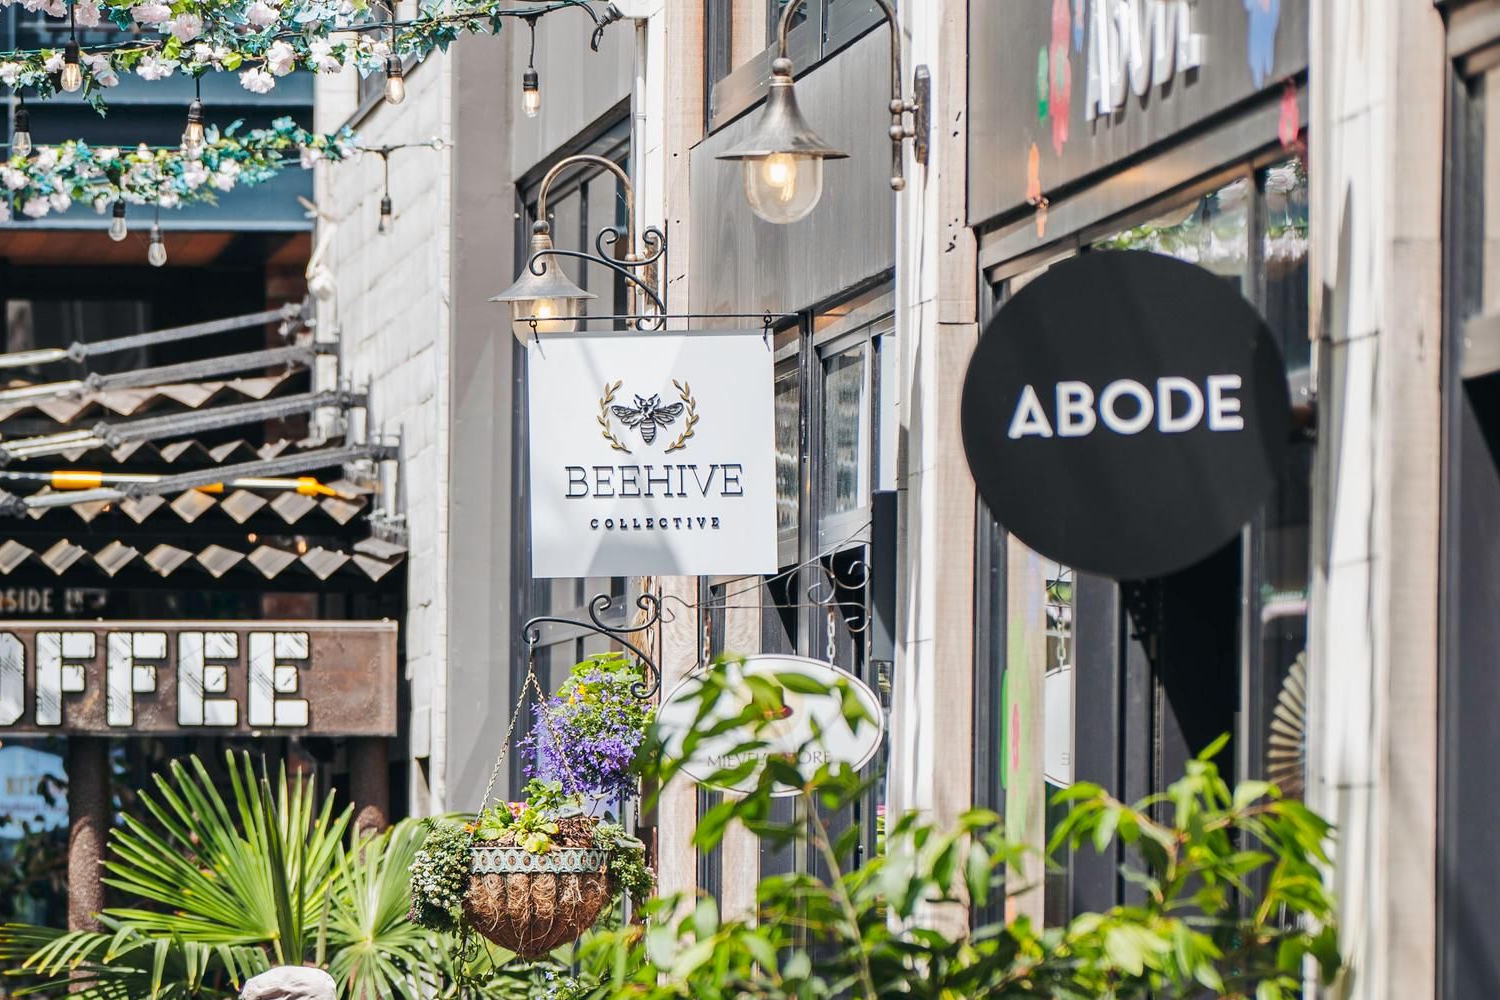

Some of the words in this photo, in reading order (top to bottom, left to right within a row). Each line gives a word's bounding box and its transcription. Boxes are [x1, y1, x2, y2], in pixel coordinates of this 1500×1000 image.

[1007, 373, 1245, 440] ABODE
[564, 463, 744, 499] BEEHIVE
[590, 516, 721, 531] COLLECTIVE
